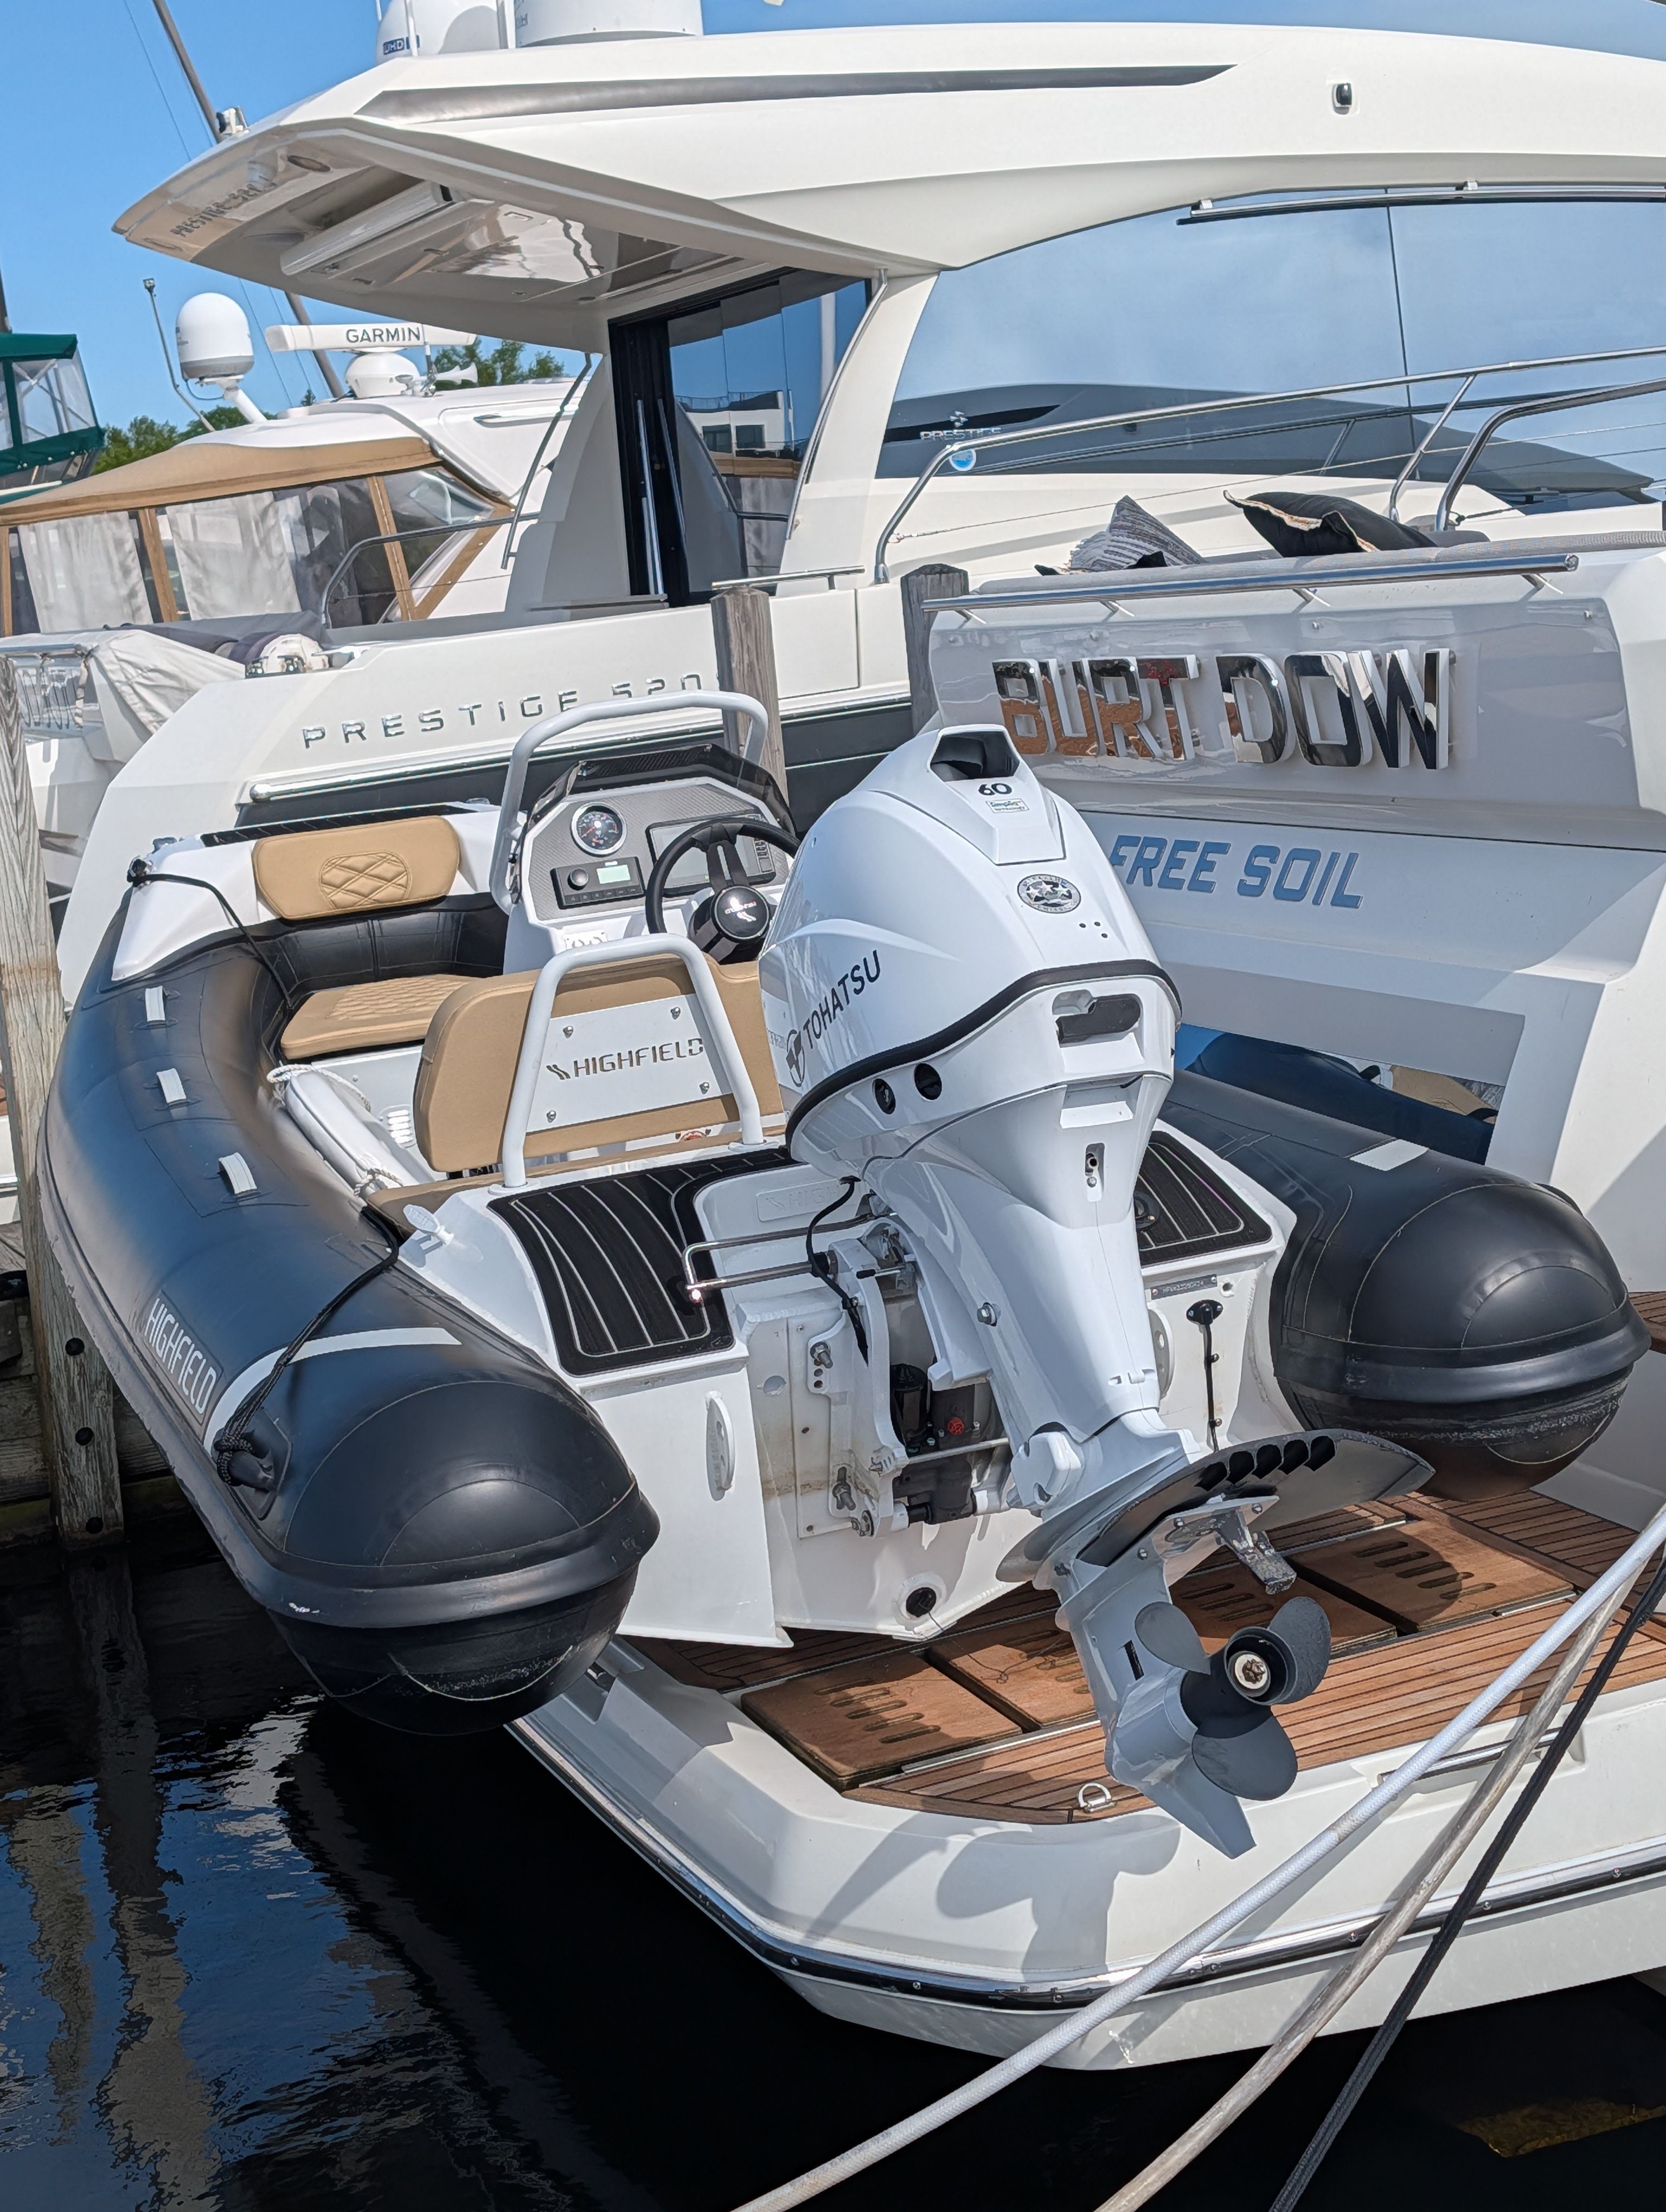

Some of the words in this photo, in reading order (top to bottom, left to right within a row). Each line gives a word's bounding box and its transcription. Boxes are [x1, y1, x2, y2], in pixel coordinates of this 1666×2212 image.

[345, 326, 420, 344] GARMIN
[303, 690, 578, 749] PRESTIGE
[992, 653, 1200, 761] BURT
[1215, 648, 1450, 770] DOW
[978, 783, 1013, 796] 60
[1108, 834, 1232, 894] FREE
[1236, 844, 1364, 909] SOIL
[803, 949, 881, 1050] TOHATSU
[573, 1038, 704, 1078] HIGHFIELD
[144, 1297, 217, 1414] HIGHFIELD
